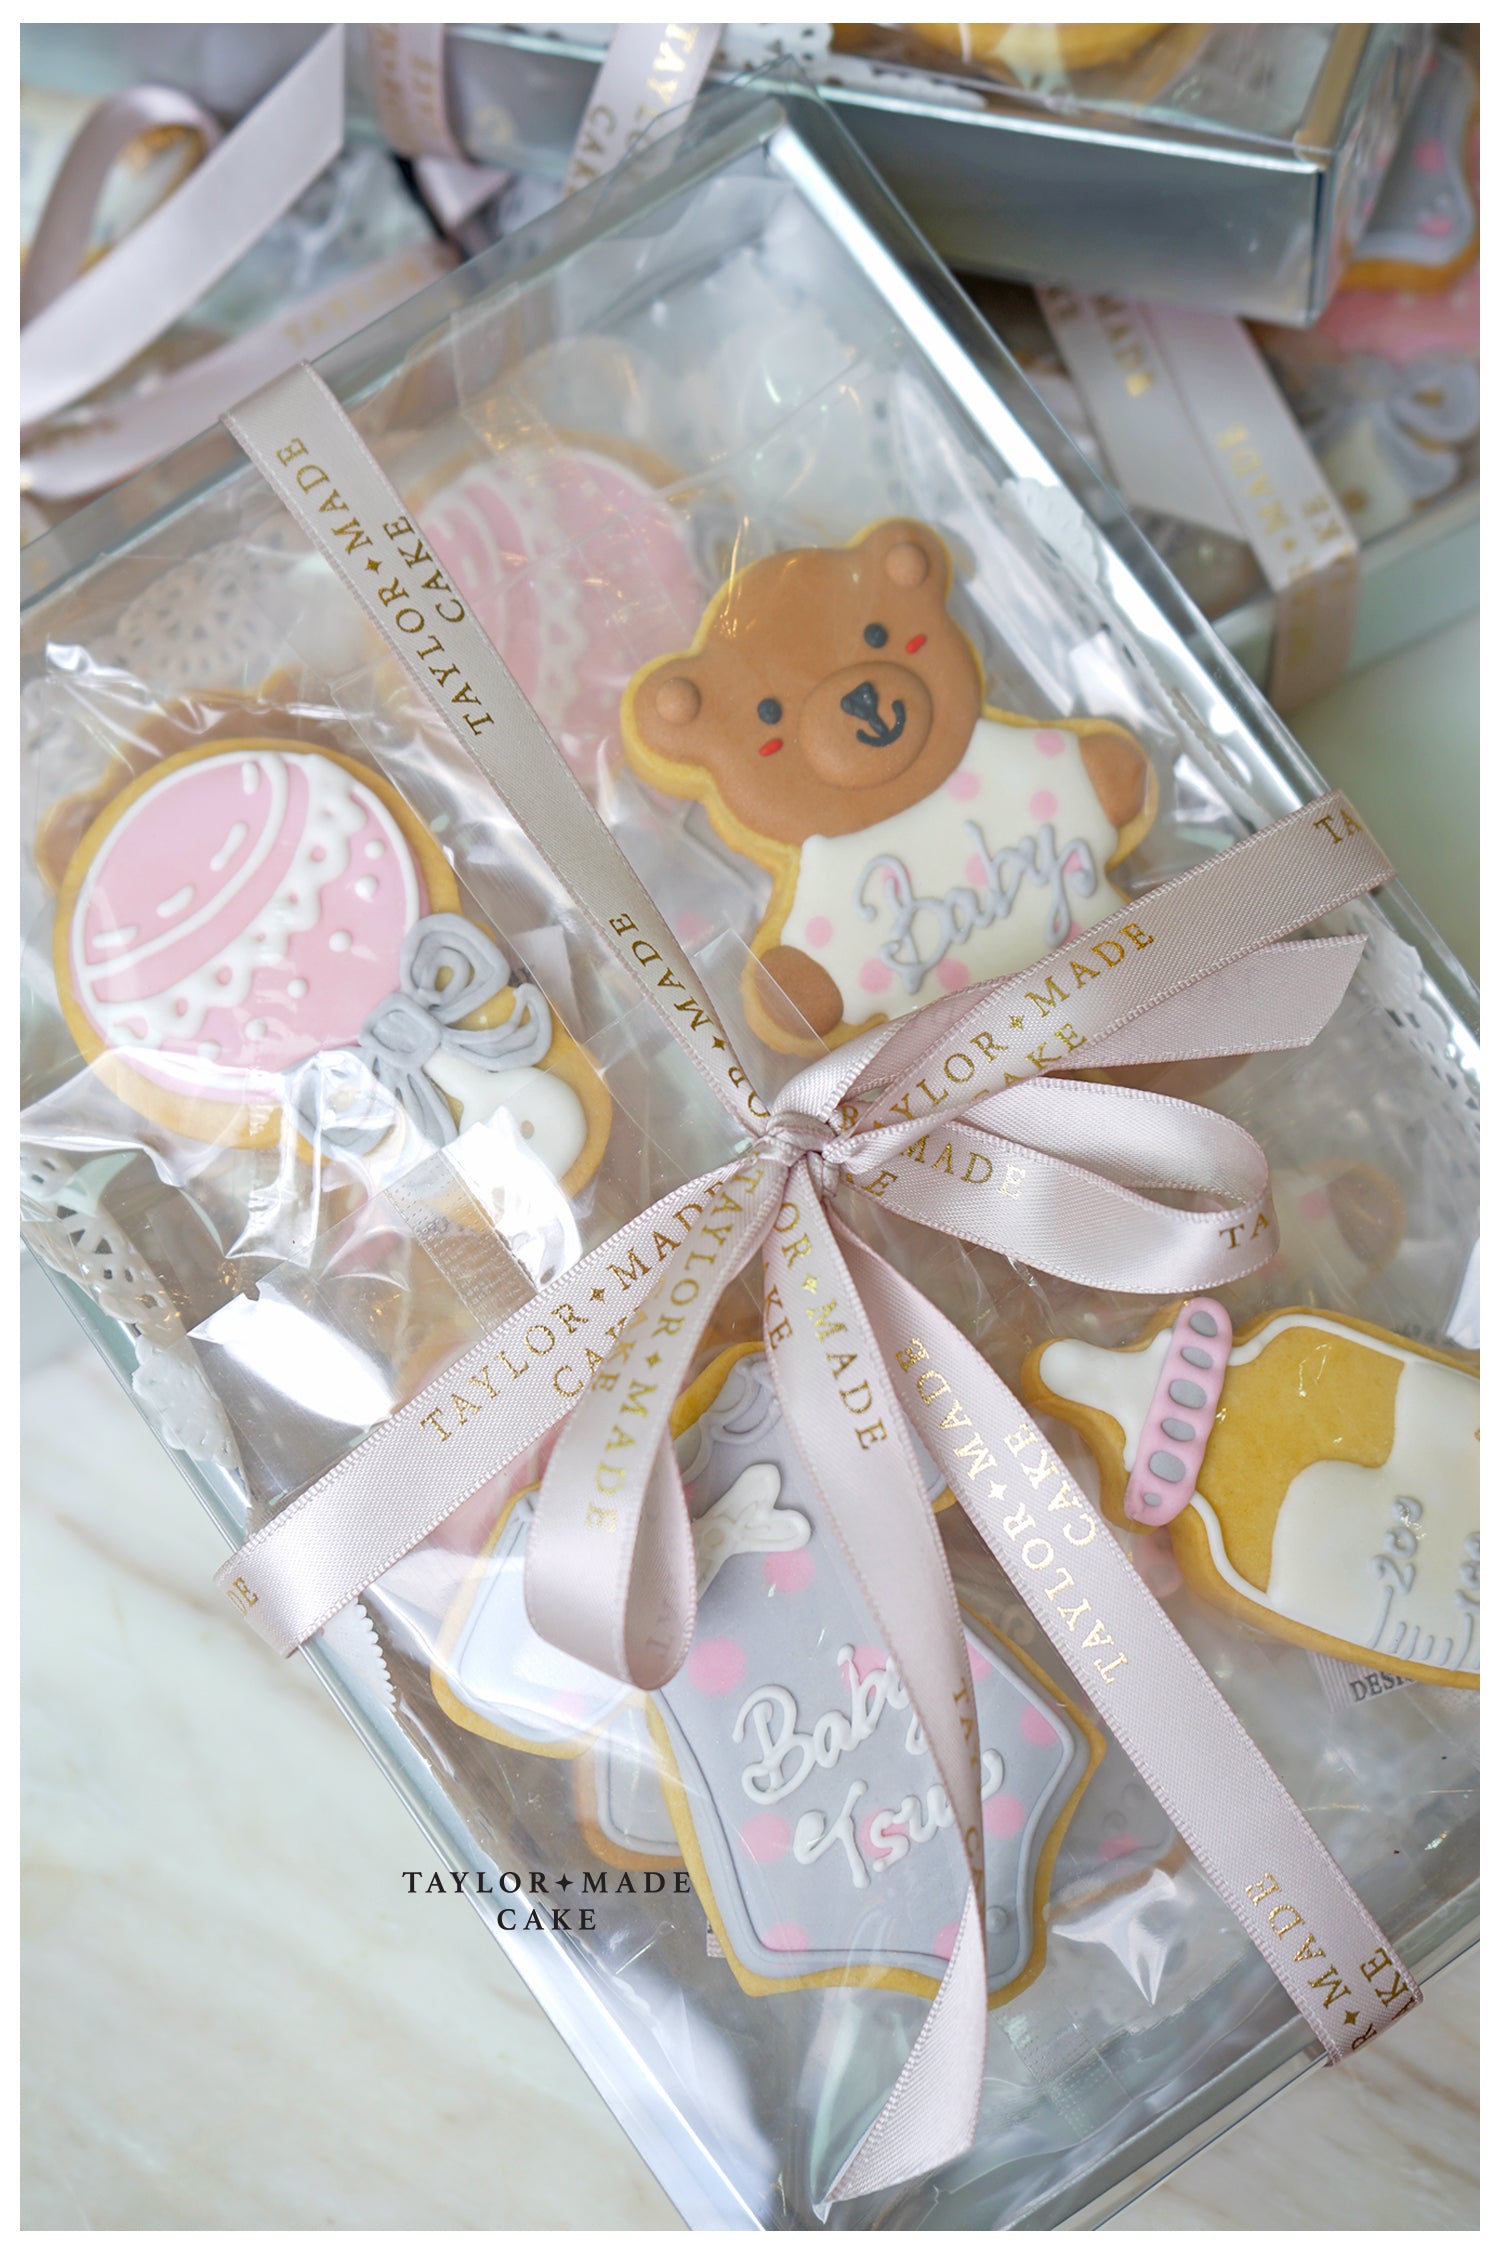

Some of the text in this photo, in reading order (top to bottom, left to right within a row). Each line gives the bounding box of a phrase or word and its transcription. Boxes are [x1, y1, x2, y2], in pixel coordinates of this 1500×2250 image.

[278, 438, 494, 736] TAYLOR MADE
[382, 515, 466, 623] CAKE
[608, 912, 713, 1031] MADE
[854, 819, 1097, 996] Baby
[1025, 923, 1155, 1018] MADE
[652, 1170, 764, 1338] TAYLOR
[420, 1303, 588, 1442] TAYLOR
[806, 1299, 888, 1452] MADE
[586, 1380, 657, 1533] MADE
[896, 1338, 1128, 1684] TAYLOR MADE
[1003, 1424, 1098, 1546] CAKE
[1246, 1872, 1351, 2010] MADE
